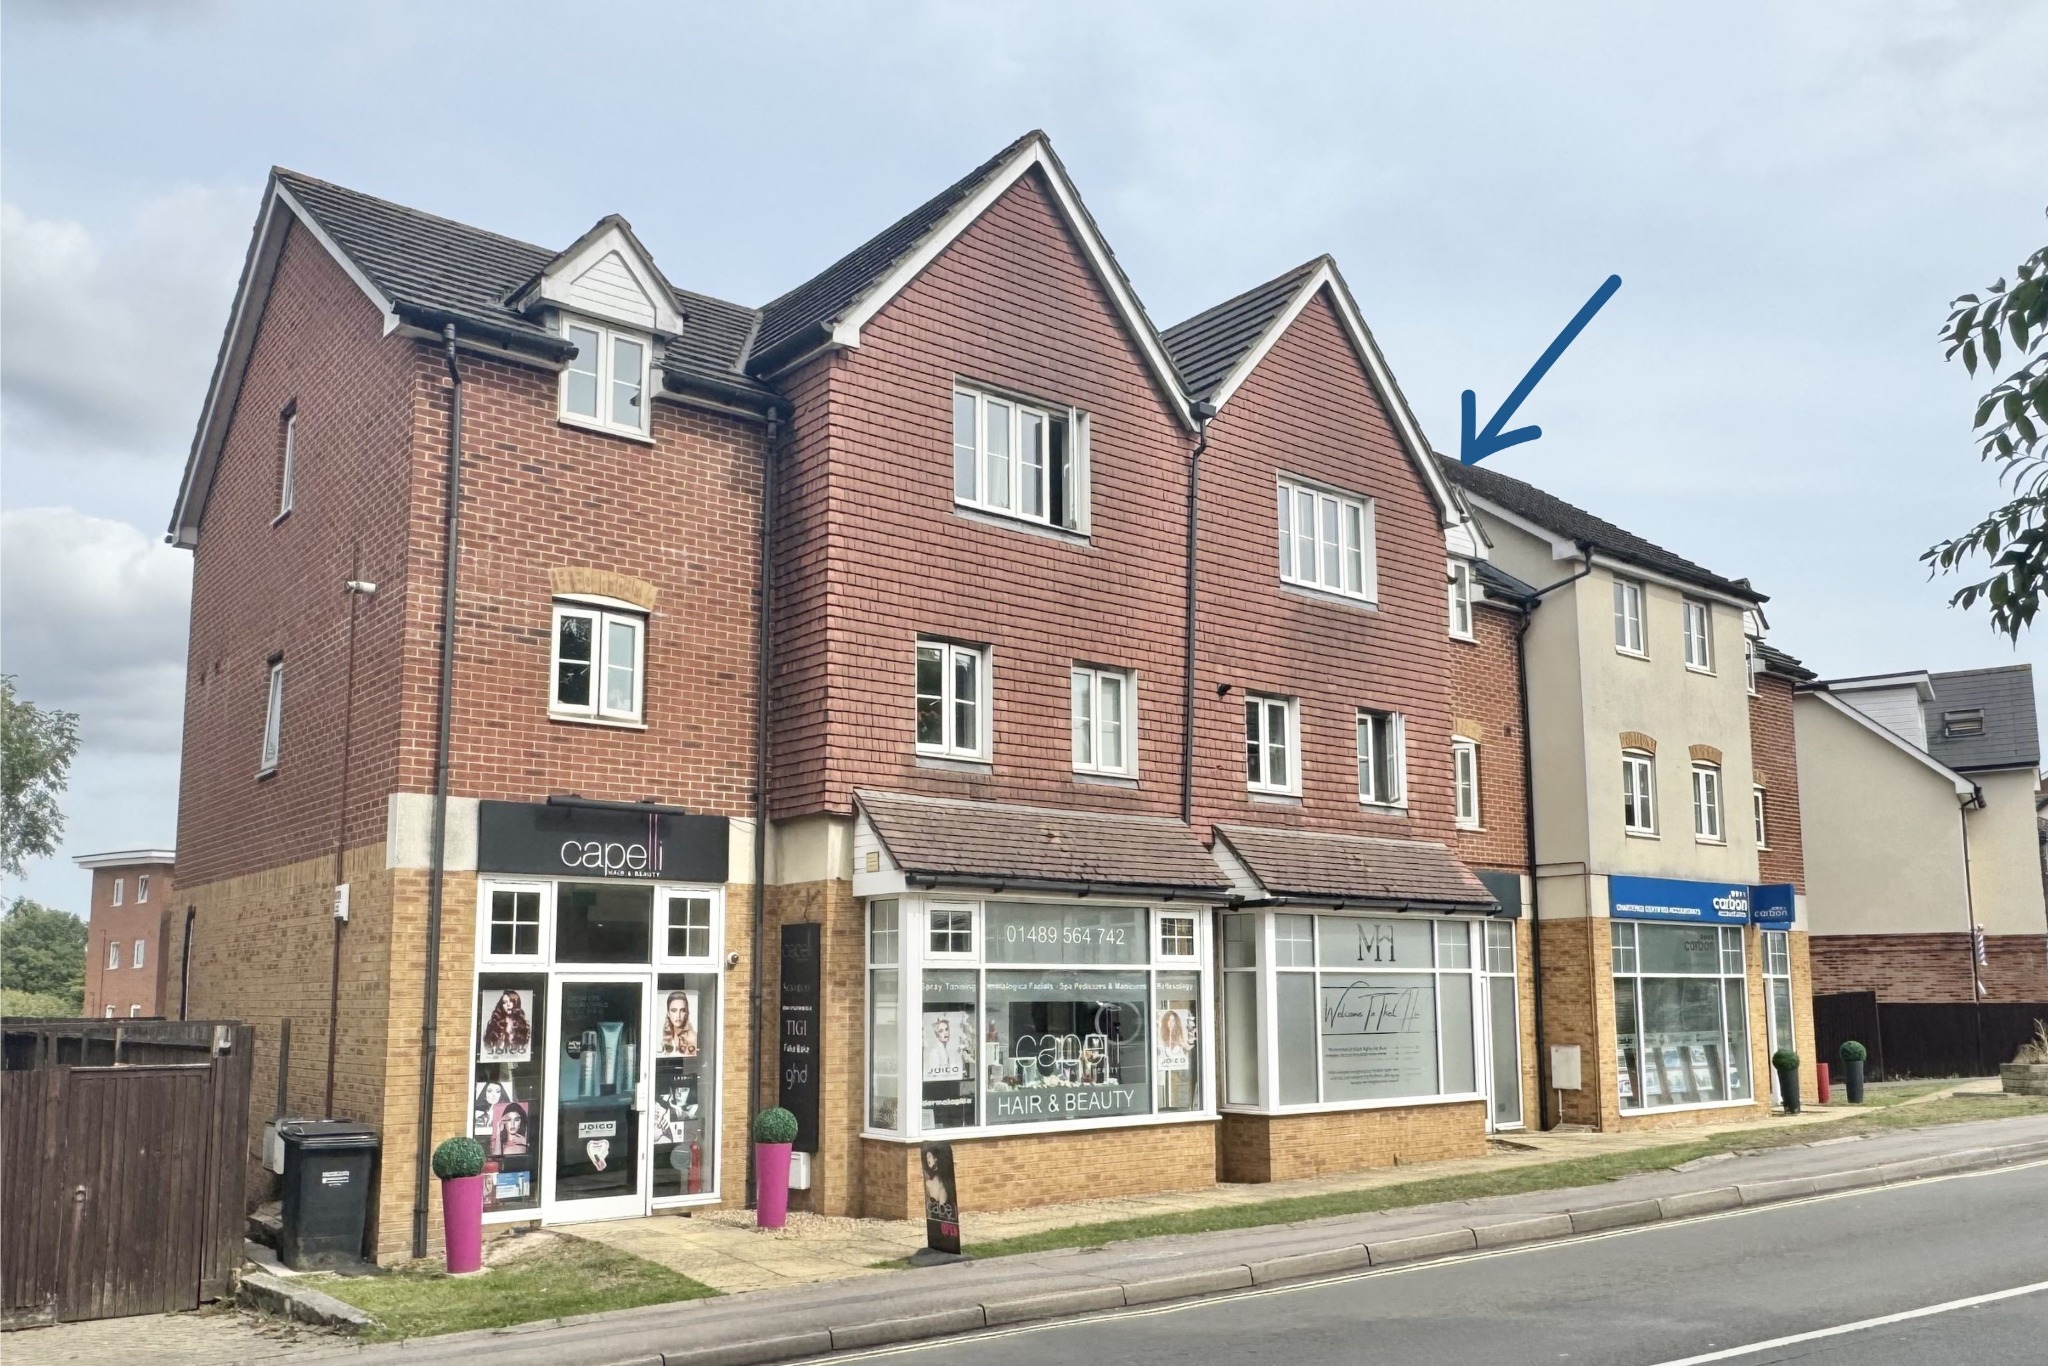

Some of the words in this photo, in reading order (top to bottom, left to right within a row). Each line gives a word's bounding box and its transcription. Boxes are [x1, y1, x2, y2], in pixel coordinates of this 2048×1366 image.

[561, 813, 663, 877] capelli
[1713, 894, 1748, 912] carbon
[1754, 908, 1788, 918] carbon
[1006, 924, 1058, 944] 01489
[1063, 926, 1092, 945] 564
[1098, 927, 1125, 946] 742
[1356, 923, 1397, 962] MH
[1684, 941, 1716, 952] carbon
[1058, 982, 1073, 991] Spa
[786, 1019, 807, 1036] TIGI
[785, 1062, 808, 1090] ghd
[998, 1094, 1043, 1116] HAIR
[1048, 1093, 1060, 1113] &
[1065, 1089, 1135, 1112] BEAUTY
[580, 1123, 614, 1131] JOICO
